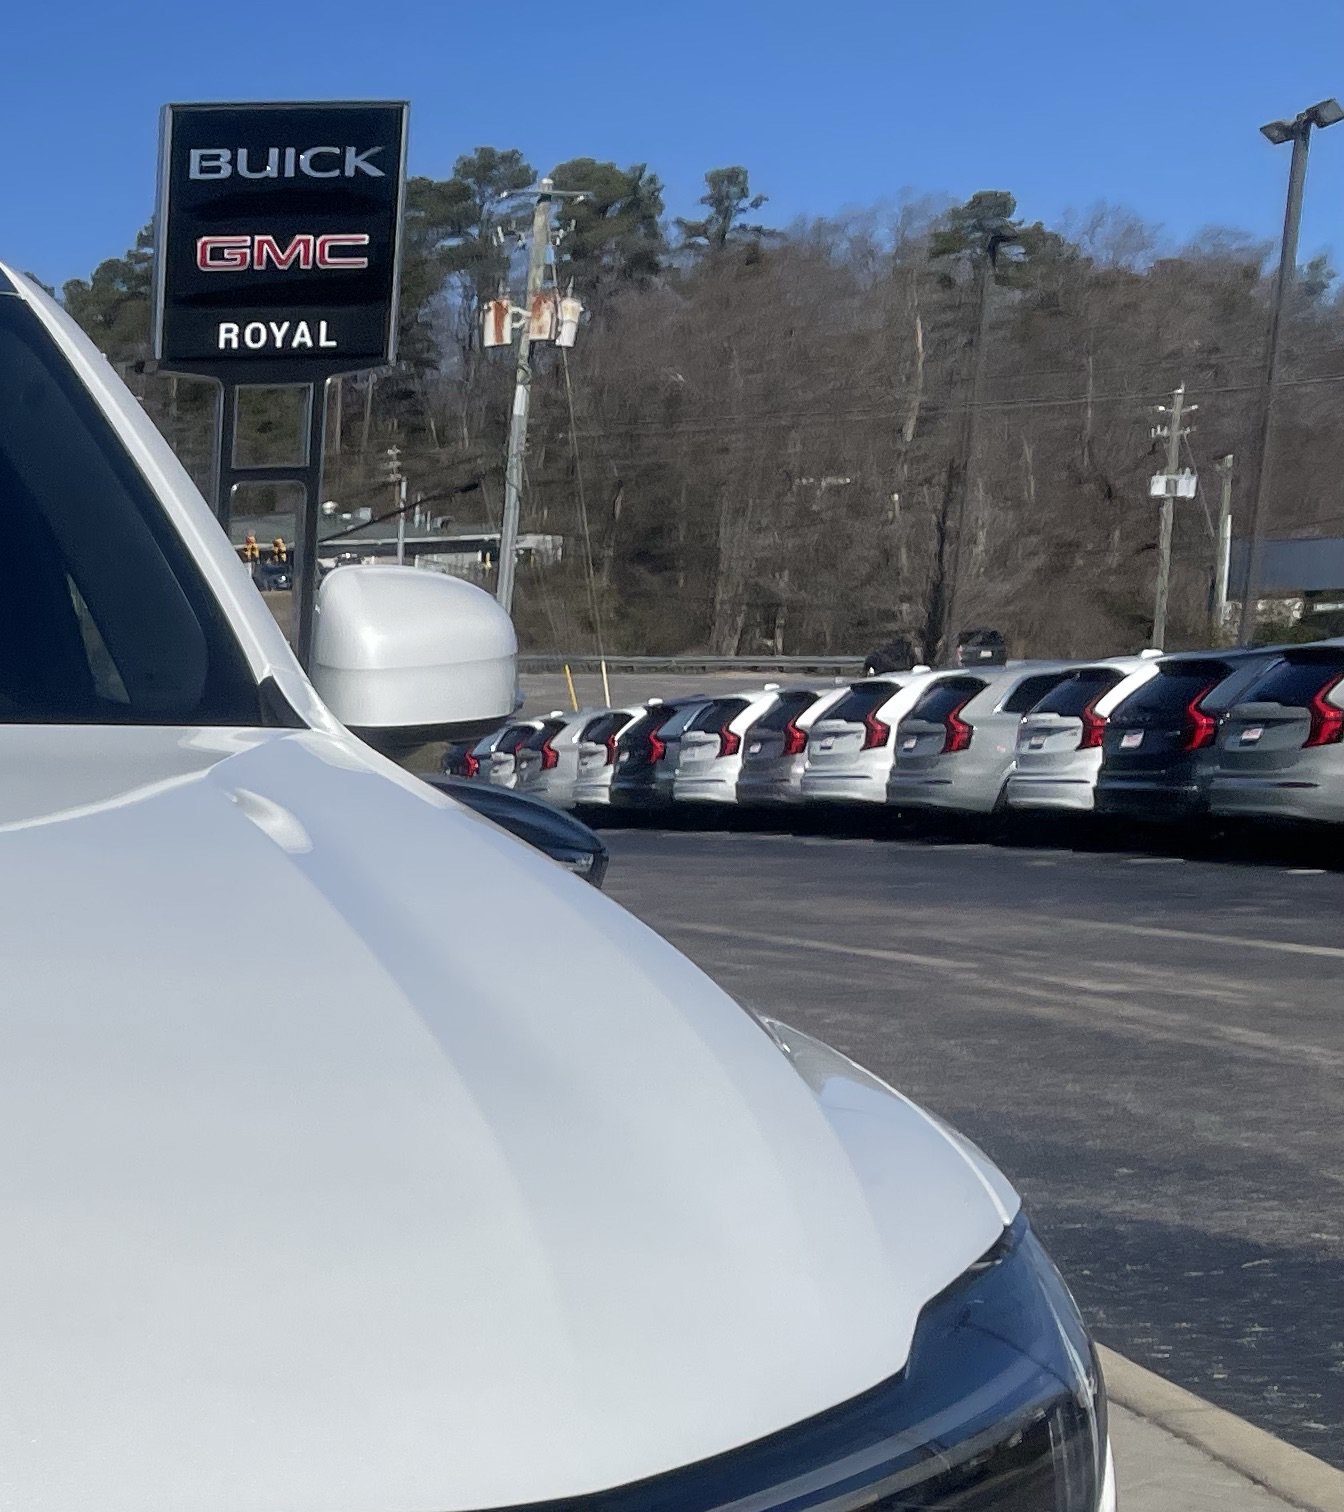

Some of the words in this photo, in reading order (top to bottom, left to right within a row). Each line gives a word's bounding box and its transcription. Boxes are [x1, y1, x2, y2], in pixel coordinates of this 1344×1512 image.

[188, 145, 386, 180] BUICK
[196, 233, 370, 272] GMC
[217, 320, 338, 349] ROYAL
